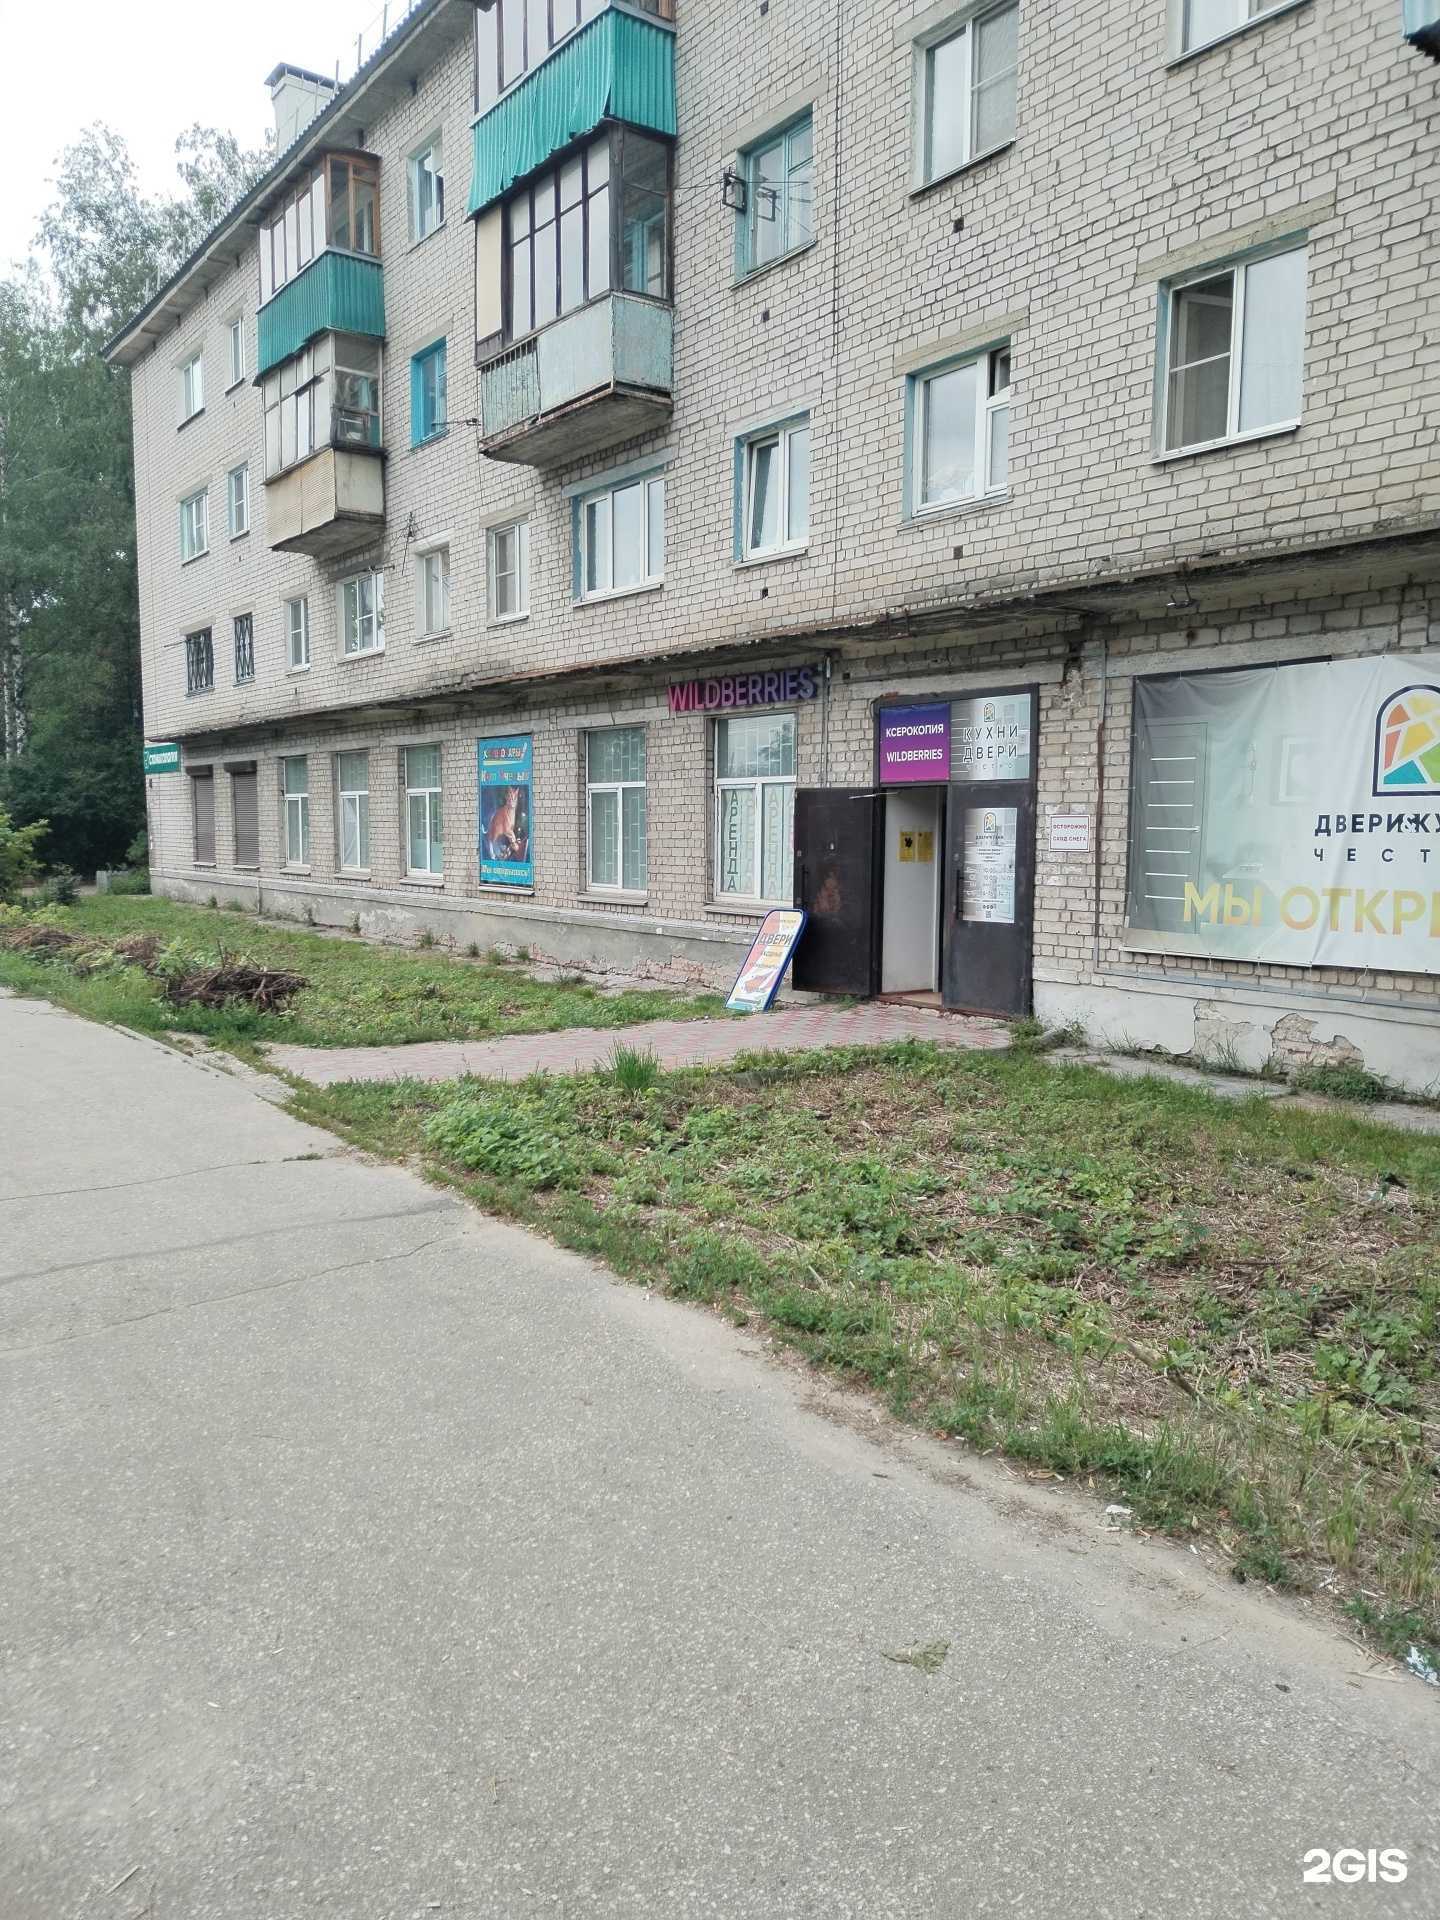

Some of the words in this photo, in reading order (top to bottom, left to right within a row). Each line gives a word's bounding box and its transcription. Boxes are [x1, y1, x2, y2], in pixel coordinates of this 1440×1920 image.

[668, 667, 814, 712] WILDBERRIES
[886, 724, 944, 737] КСЕРОКОПИЯ
[963, 725, 1018, 742] КУХНИ
[886, 749, 943, 763] WILDBERRIES
[962, 745, 1018, 763] ДВЕРИ
[727, 790, 738, 891] АРЕНДА
[1183, 881, 1264, 927] МЫ
